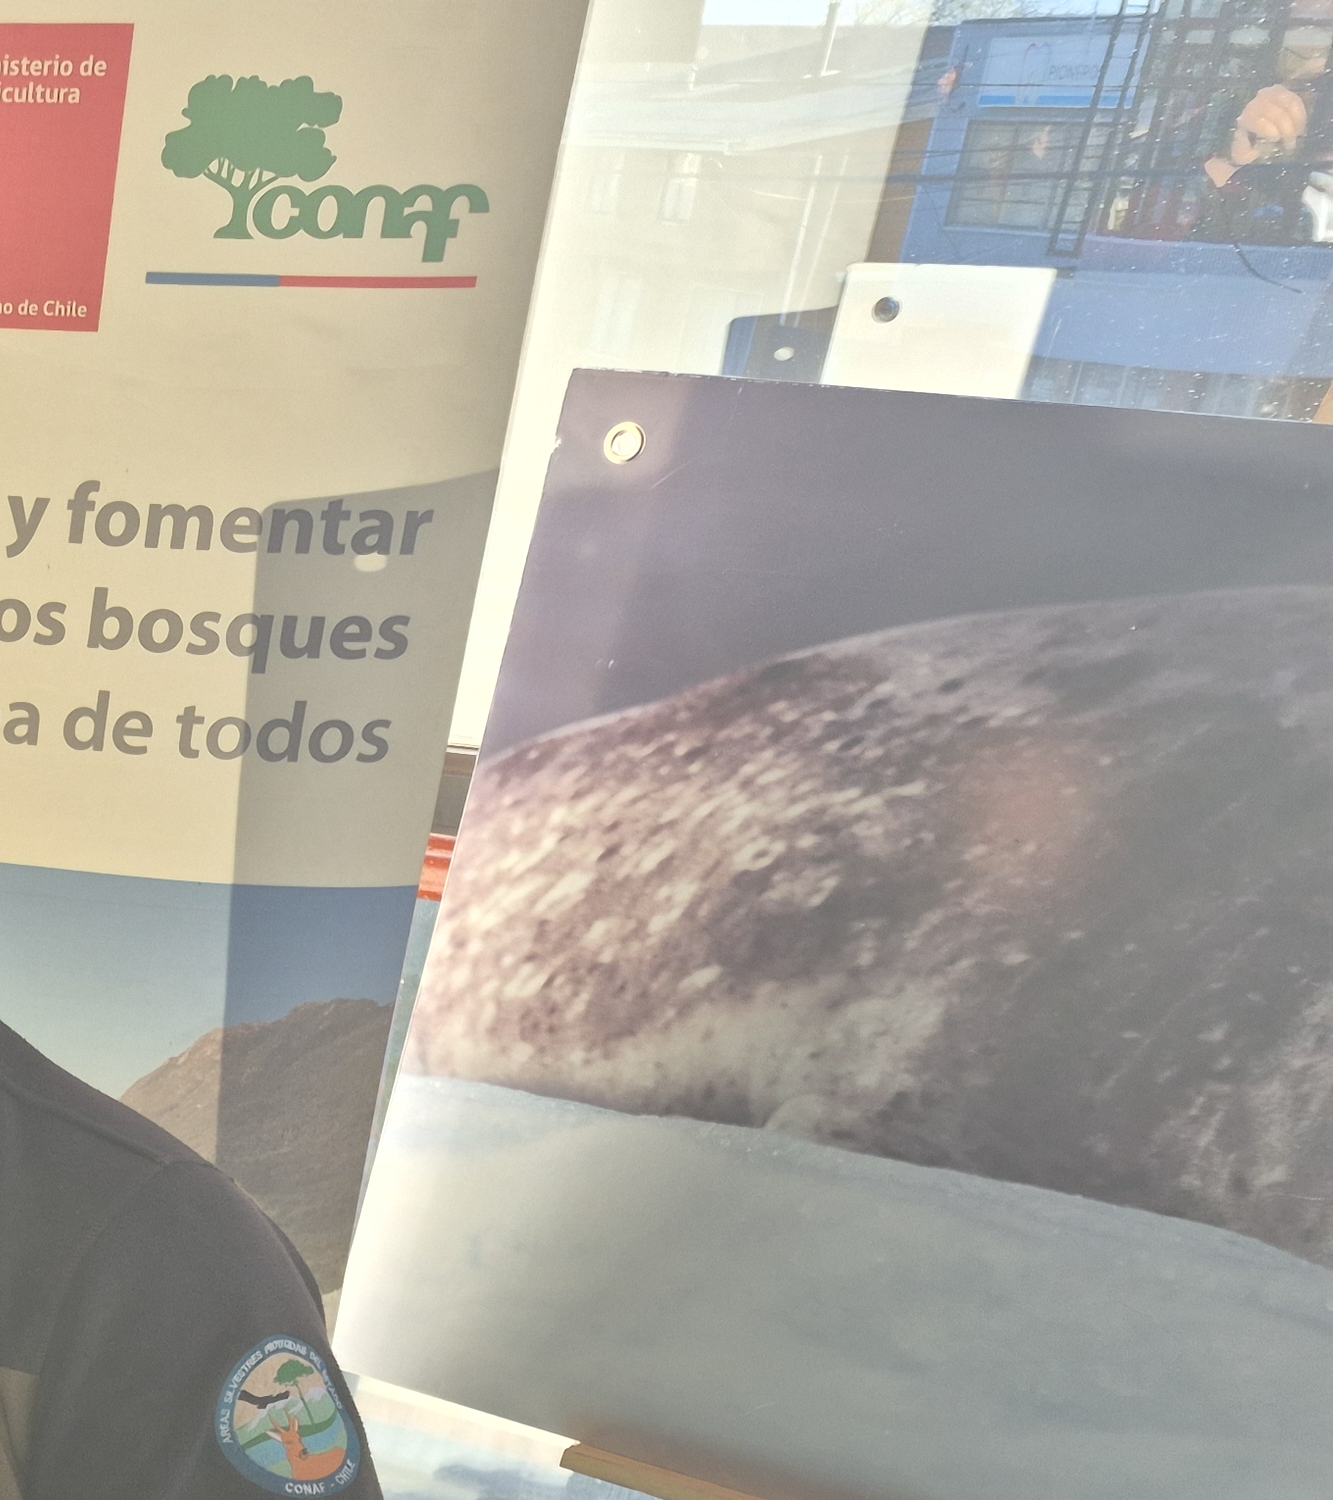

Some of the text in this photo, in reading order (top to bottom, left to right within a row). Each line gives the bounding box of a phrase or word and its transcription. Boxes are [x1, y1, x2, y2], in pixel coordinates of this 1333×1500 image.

[80, 55, 107, 79] de
[18, 298, 38, 317] de
[42, 298, 88, 319] Chile
[6, 491, 52, 557] y
[67, 480, 433, 557] fomentar
[86, 585, 410, 673] bosques
[62, 690, 152, 760] de
[176, 702, 391, 765] todos
[285, 1482, 326, 1495] CONAF
